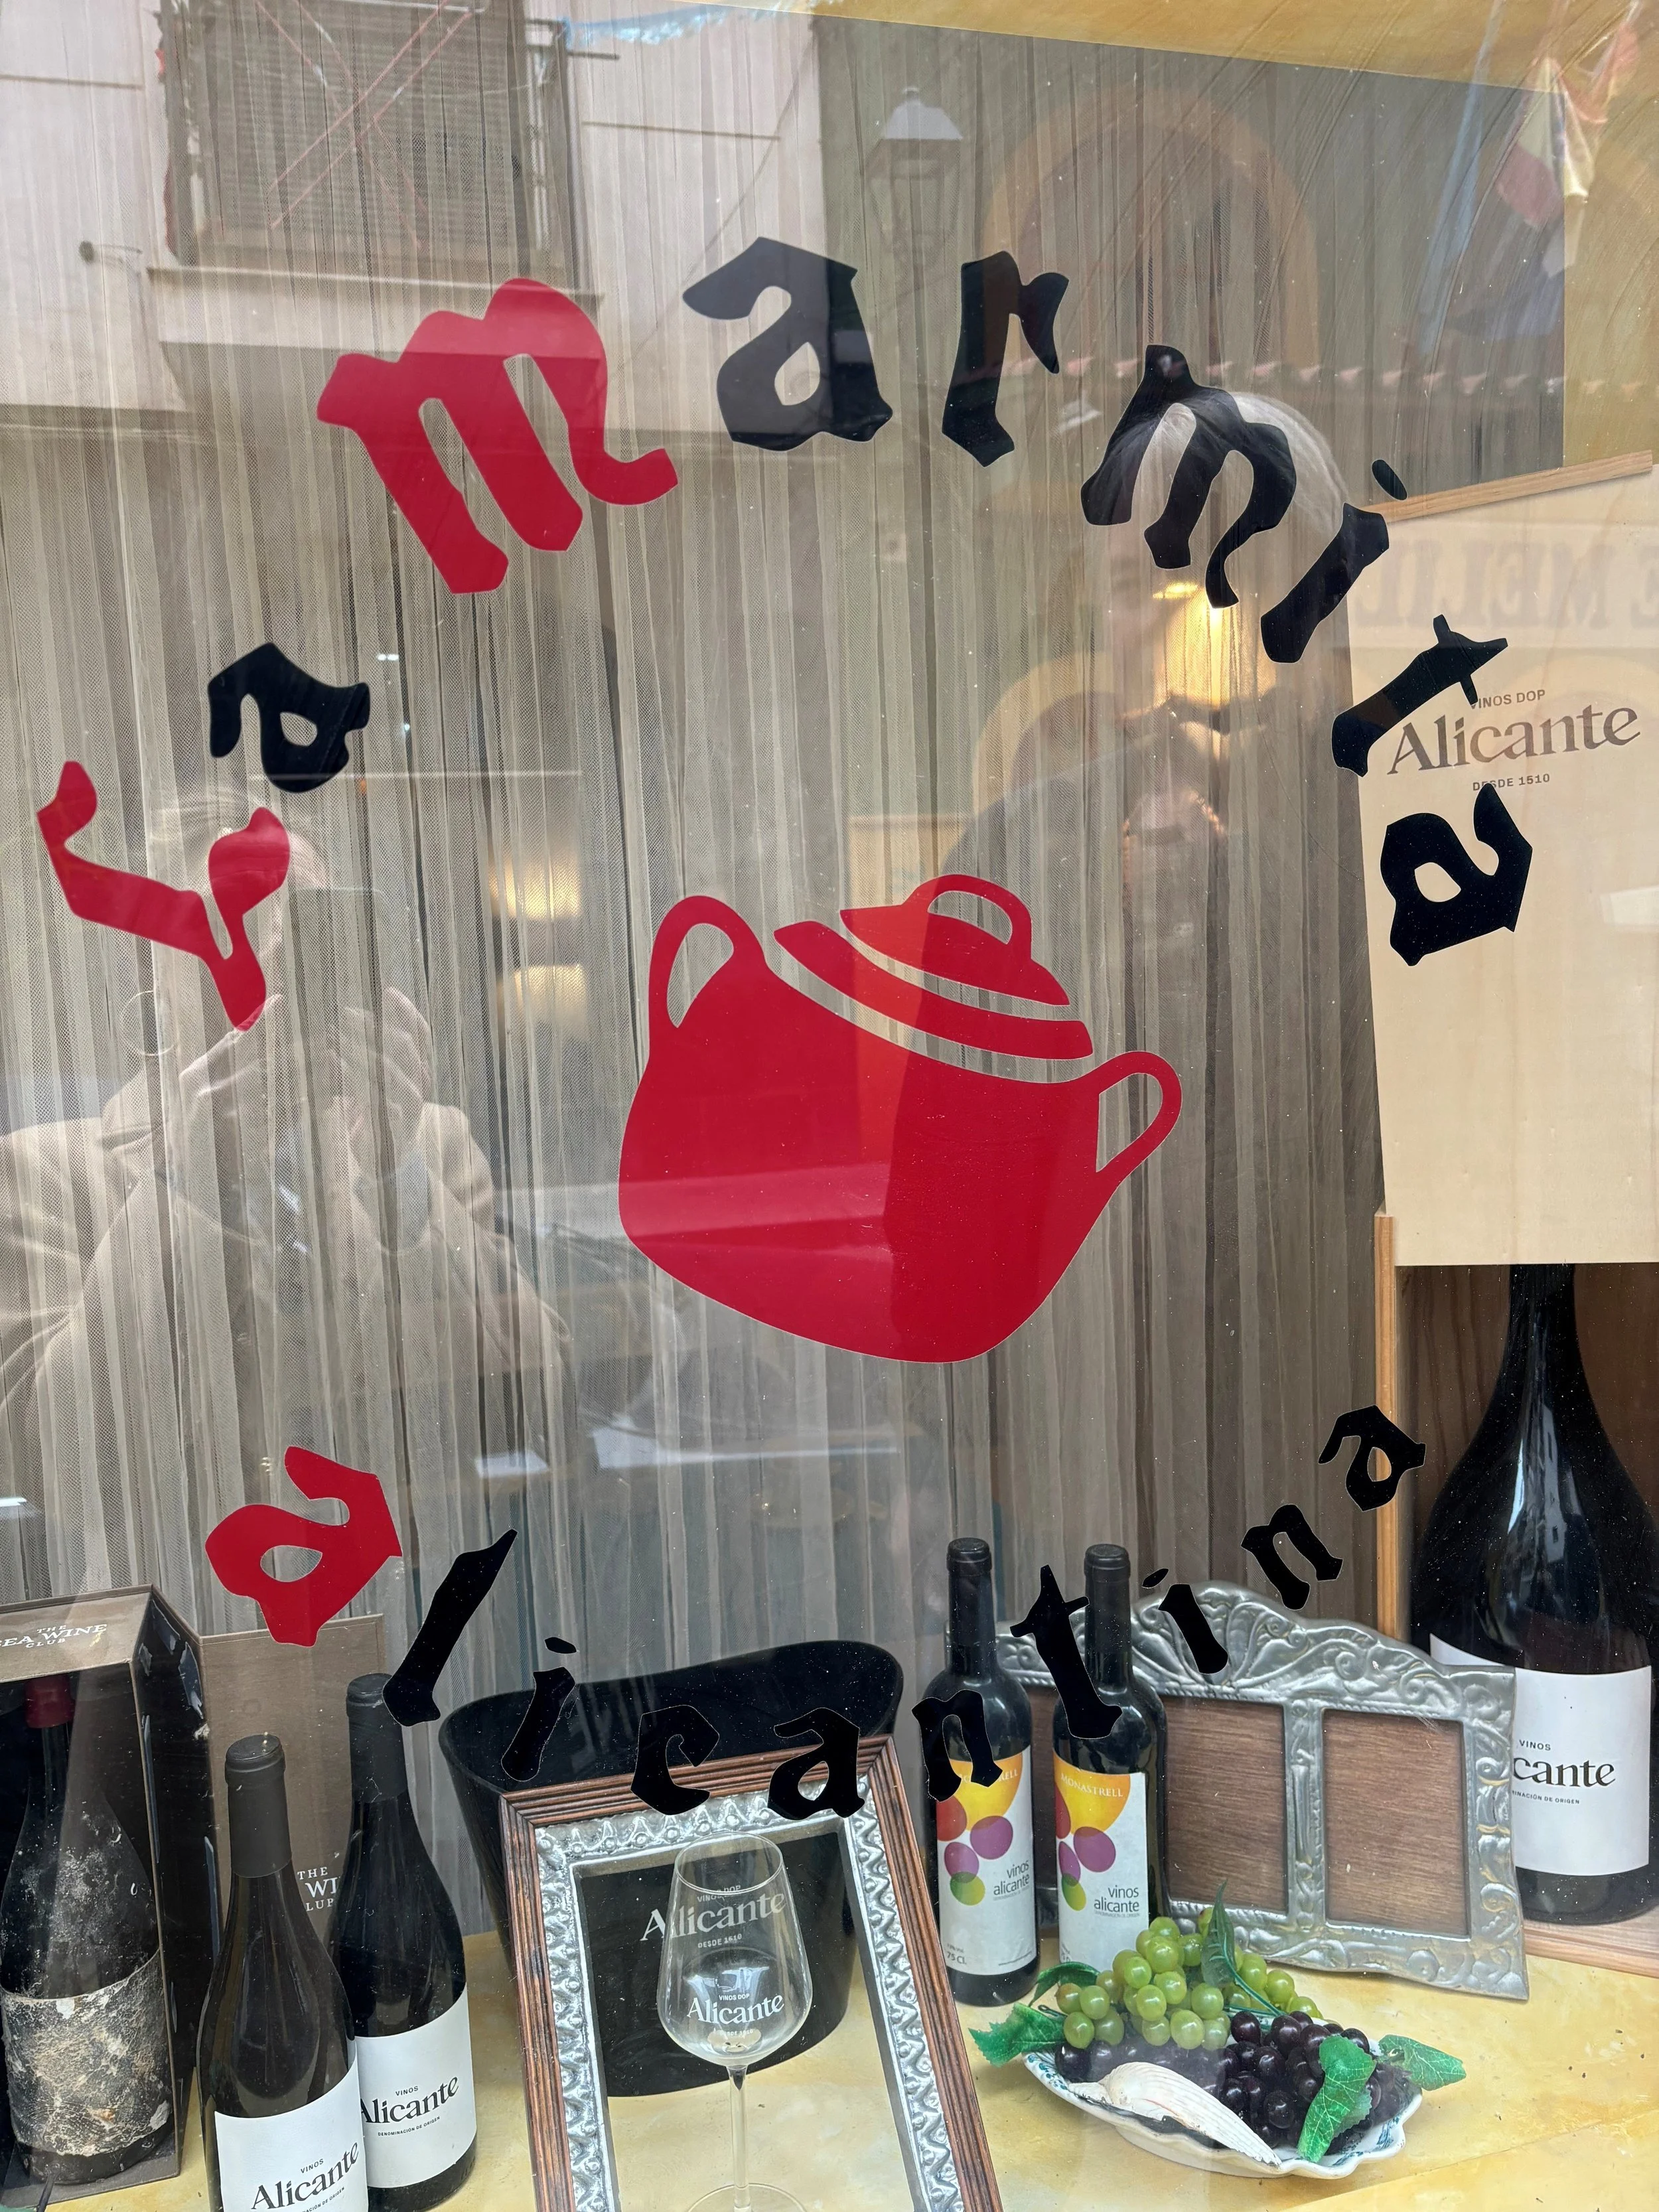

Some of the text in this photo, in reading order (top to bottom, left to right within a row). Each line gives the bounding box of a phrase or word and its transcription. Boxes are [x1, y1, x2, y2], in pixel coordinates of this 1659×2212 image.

[1471, 690, 1546, 709] INOS DOP
[1386, 704, 1640, 775] Alicante
[1518, 773, 1550, 786] 1510
[0, 1623, 108, 1647] EA WINE
[36, 1625, 67, 1634] THE
[26, 1638, 66, 1649] CLUB
[1519, 1739, 1551, 1751] VINOS
[1513, 1757, 1616, 1787] cante
[1061, 1773, 1123, 1797] MONASTRELL
[1512, 1790, 1542, 1801] INACIÓN
[297, 1866, 328, 1880] THE
[1006, 1860, 1030, 1879] vinos
[305, 1876, 338, 1898] WI
[993, 1874, 1030, 1895] alicante
[1108, 1884, 1139, 1898] vinos
[305, 1897, 334, 1912] LUB
[1094, 1896, 1139, 1913] alicante
[639, 1891, 786, 1941] Alicante
[697, 1938, 723, 1949] DESDE
[686, 1994, 785, 2025] Alicante
[395, 2085, 419, 2097] VINOS
[378, 2126, 415, 2136] DENOMINACIÓN
[423, 2116, 441, 2127] ORIGEN
[300, 2158, 325, 2174] VINOS
[250, 2142, 360, 2210] Alicante
[329, 2186, 345, 2201] ORIGEN
